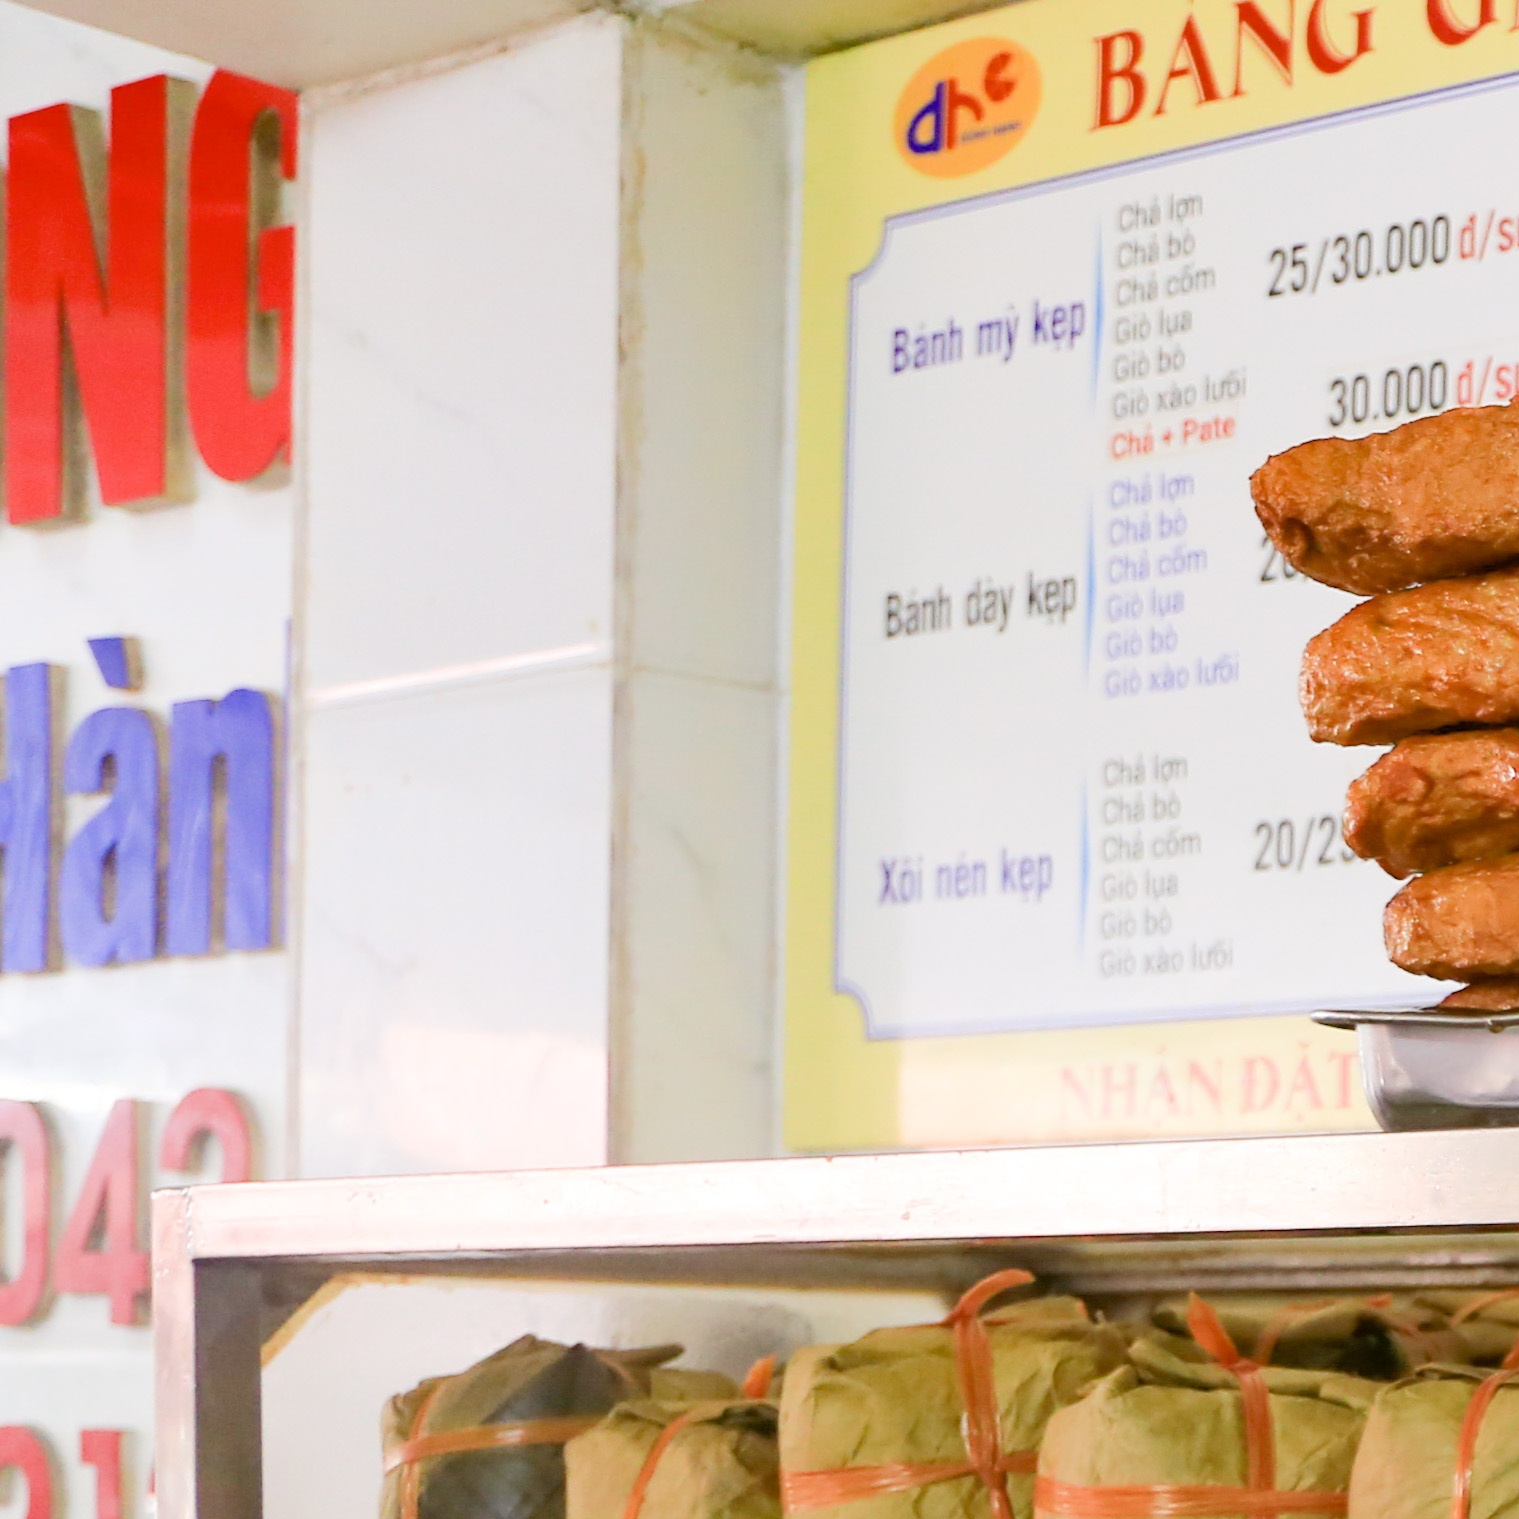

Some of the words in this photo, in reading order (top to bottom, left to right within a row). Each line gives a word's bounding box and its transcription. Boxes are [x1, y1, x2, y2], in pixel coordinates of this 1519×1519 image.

[1267, 214, 1451, 297] 25/30.000
[0, 68, 300, 525] NG
[893, 315, 963, 373] Bánh
[1033, 298, 1085, 351] kẹp
[1328, 360, 1448, 427] 30.000
[1182, 416, 1236, 446] Pate
[885, 583, 952, 638] Bánh
[1026, 569, 1076, 624] kẹp
[879, 853, 923, 907] Xôi
[1000, 845, 1052, 903] kẹp
